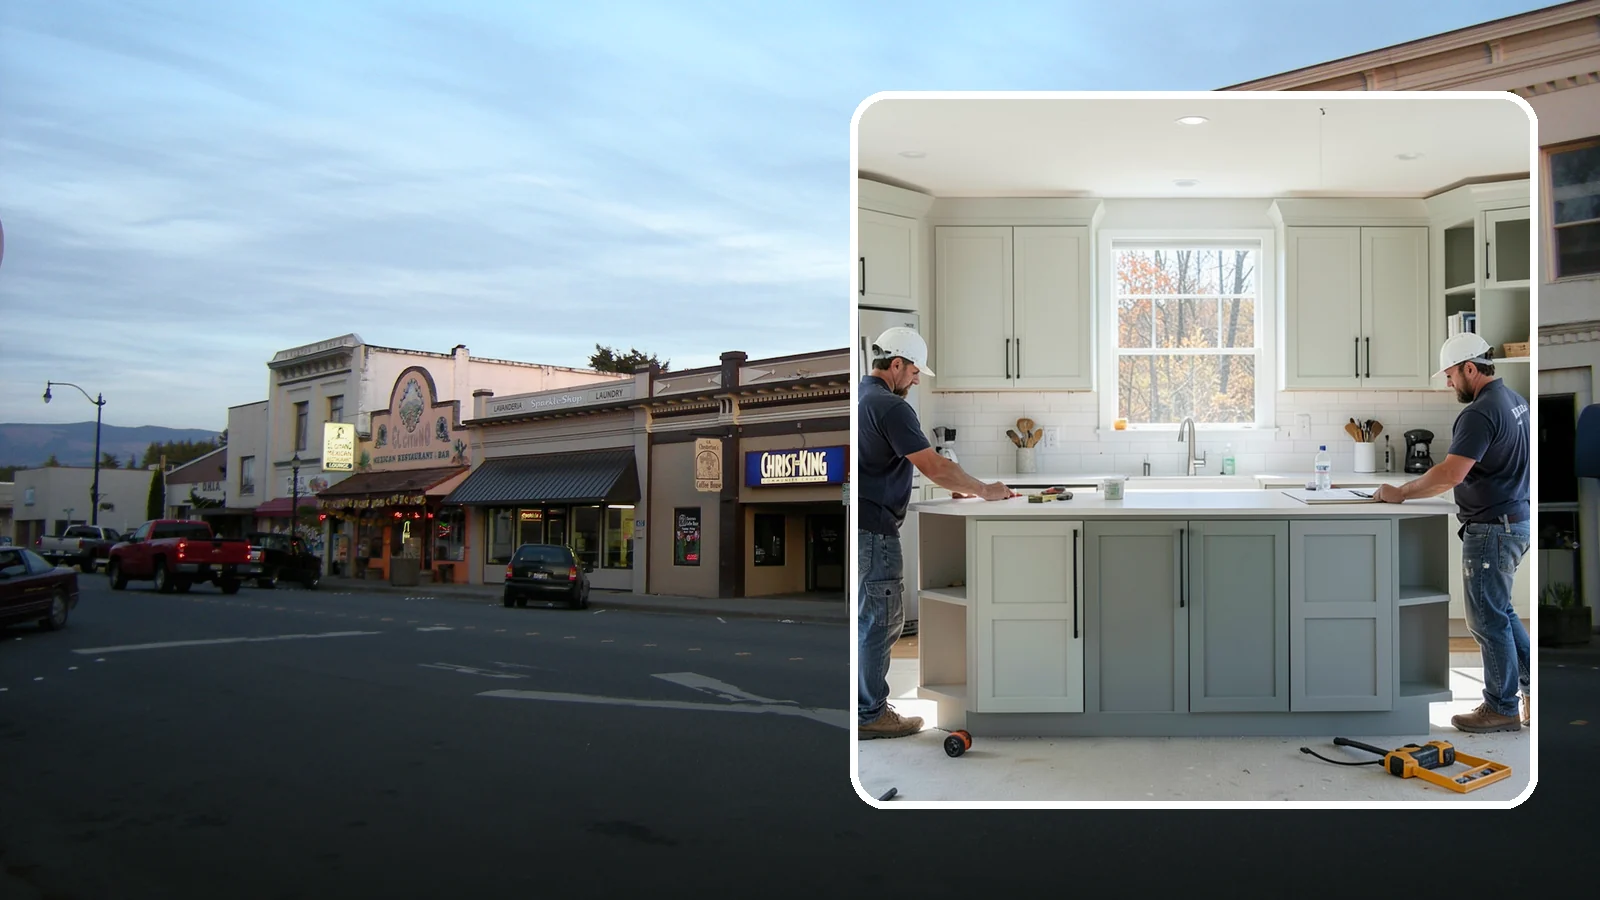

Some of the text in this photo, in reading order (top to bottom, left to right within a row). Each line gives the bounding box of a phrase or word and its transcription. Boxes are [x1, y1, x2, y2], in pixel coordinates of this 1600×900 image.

[493, 402, 523, 413] LAVANDERIA
[595, 388, 624, 400] LAUNDRY
[374, 450, 450, 464] MEXICAN RESTAURANT BAR
[760, 450, 827, 478] CHRIST KING
